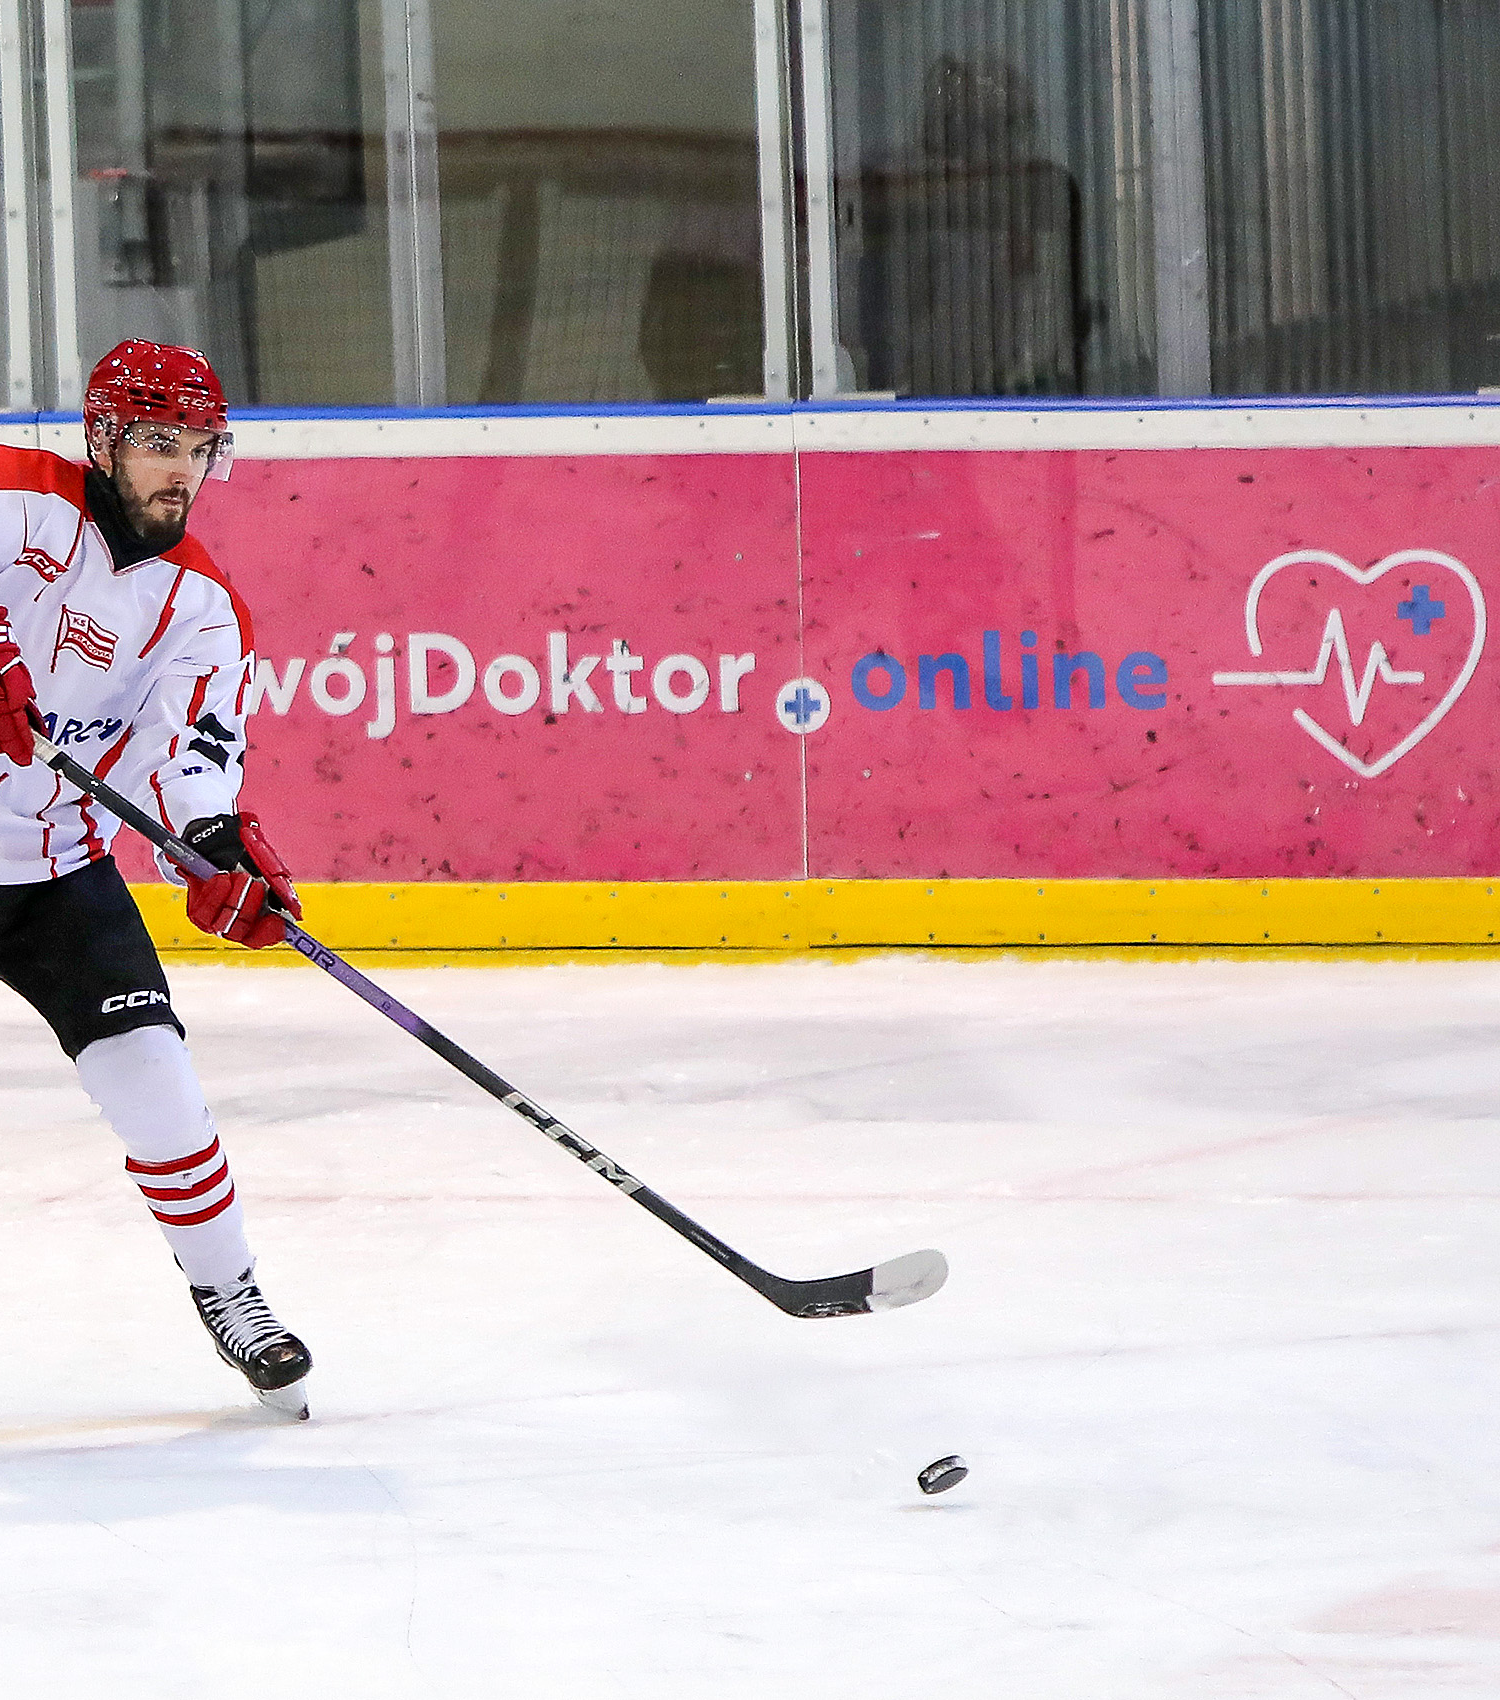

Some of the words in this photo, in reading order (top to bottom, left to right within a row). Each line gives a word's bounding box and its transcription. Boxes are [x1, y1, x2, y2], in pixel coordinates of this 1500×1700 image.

[19, 551, 64, 579] CCM
[851, 630, 1169, 712] online
[192, 820, 224, 844] CCM
[101, 989, 169, 1014] CCM
[502, 1091, 645, 1196] CCM
